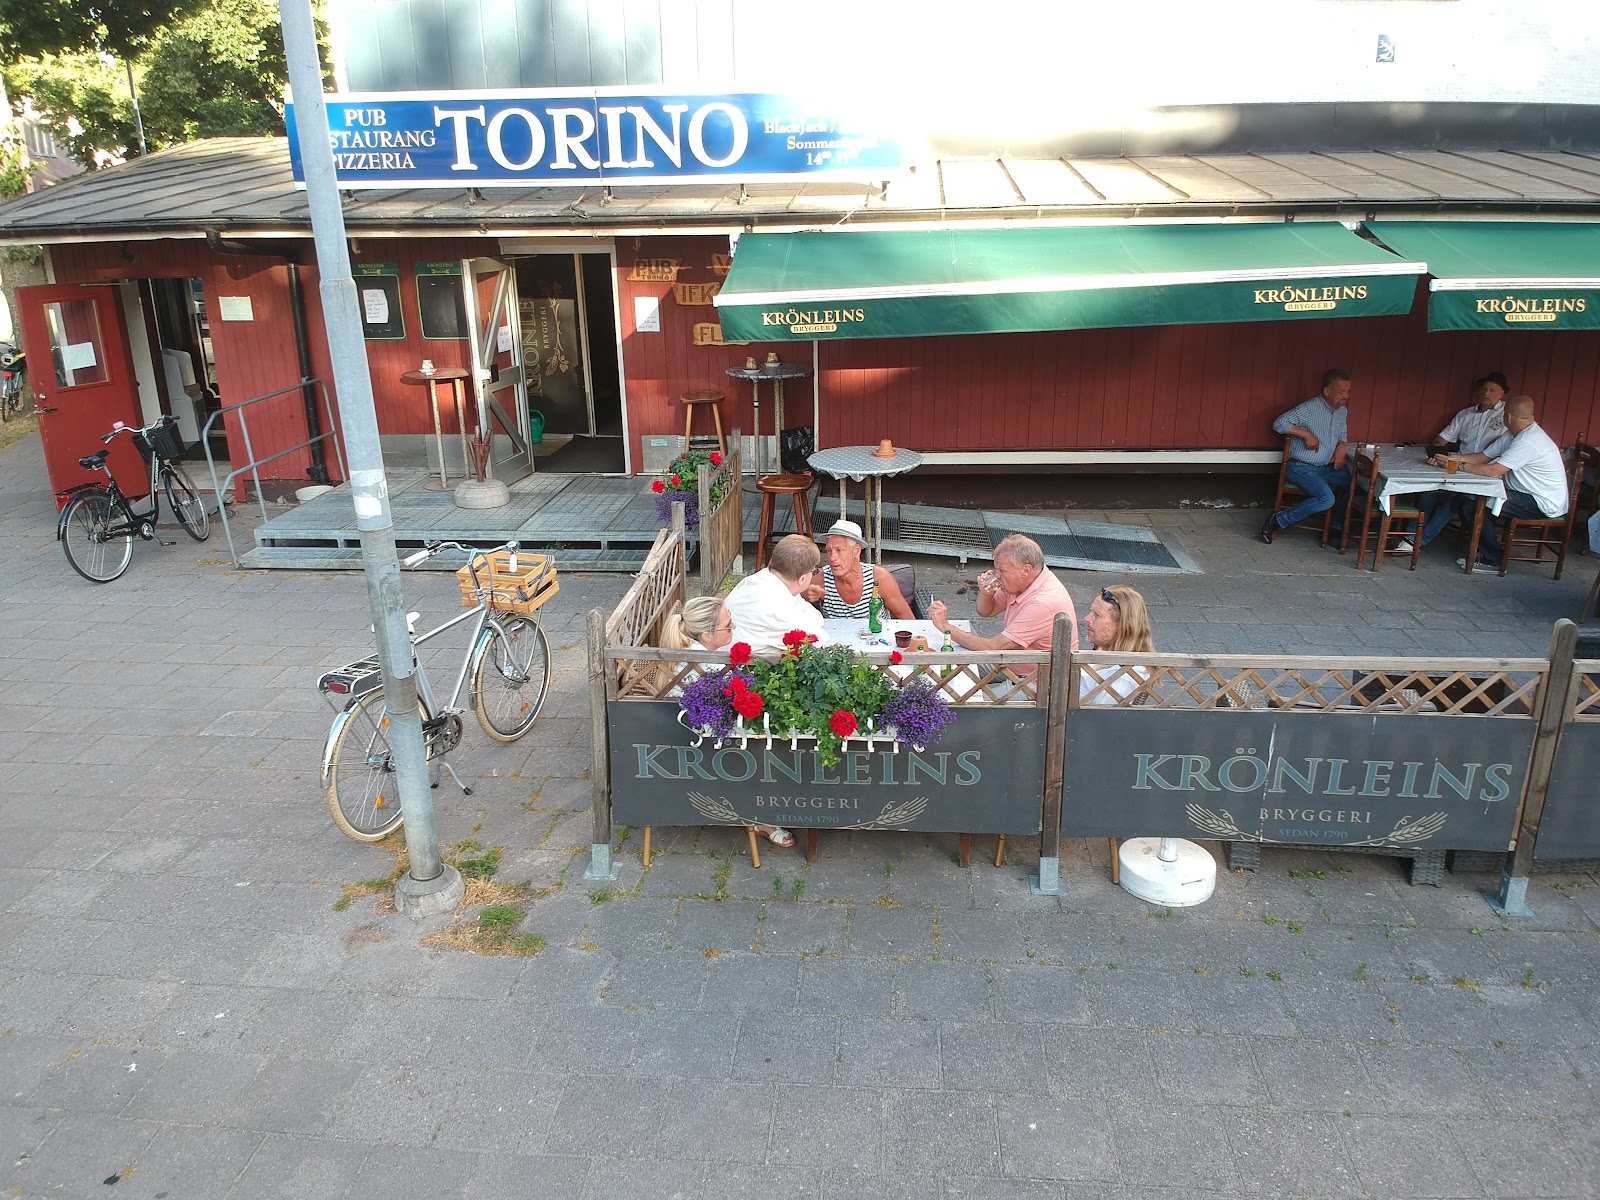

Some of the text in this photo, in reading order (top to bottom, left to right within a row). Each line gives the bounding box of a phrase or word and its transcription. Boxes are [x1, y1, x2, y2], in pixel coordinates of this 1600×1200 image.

[344, 109, 387, 127] PUB
[329, 130, 437, 149] STAURANG
[434, 102, 749, 171] TORINO
[635, 259, 673, 277] PUB
[682, 285, 715, 303] IFK
[1253, 286, 1368, 304] KRÖNLEINS
[1287, 302, 1334, 310] BRYGGERI
[1475, 296, 1586, 313] KRÖNLEINS
[761, 308, 865, 326] KRÖNLEINS
[540, 306, 550, 349] BRYGGERI
[700, 326, 722, 343] FL
[793, 324, 836, 332] BRYGGERI
[632, 739, 982, 786] KRÖNLEINS
[1131, 747, 1513, 802] KRÖNLEINS
[756, 795, 859, 809] BRYGGERI
[775, 814, 840, 824] SEDAN 1790
[1259, 807, 1371, 824] BRYGGERI
[1279, 828, 1348, 840] SEDAN 1790
